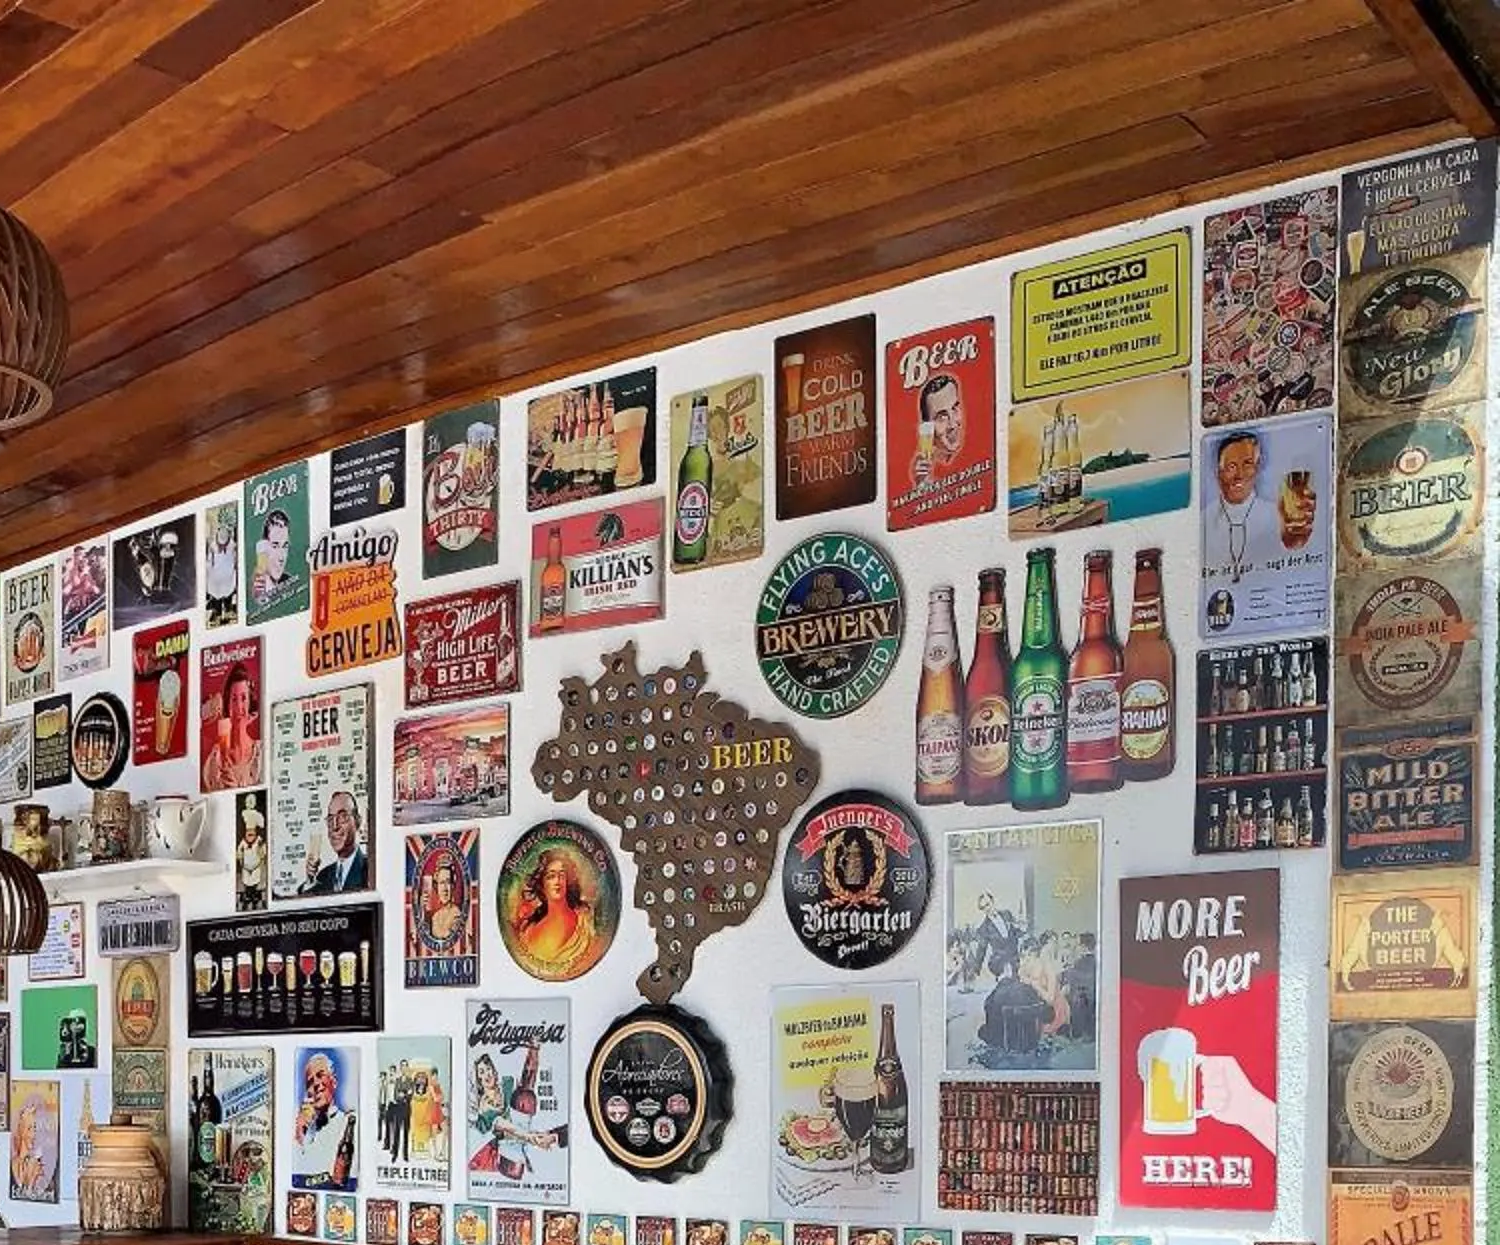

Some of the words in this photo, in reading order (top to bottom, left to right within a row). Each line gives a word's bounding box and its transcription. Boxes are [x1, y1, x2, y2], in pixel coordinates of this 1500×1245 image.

[1358, 162, 1423, 189] VERGONHA
[1425, 156, 1441, 173] NA
[1445, 147, 1479, 168] CARA
[1375, 184, 1413, 204] IGUAL
[1056, 263, 1143, 296] ATENÇÃO
[1405, 275, 1462, 299] BEER
[803, 369, 863, 401] COLD
[1379, 346, 1462, 398] Glory
[786, 391, 868, 444] BEER
[786, 447, 868, 487] FRIENDS
[1349, 471, 1473, 521] BEER
[309, 533, 393, 570] Amigo
[569, 554, 654, 589] KILLIAN'S
[764, 541, 826, 612] FLYING
[8, 572, 51, 614] BEER
[442, 594, 507, 638] Miller
[763, 605, 895, 655] BREWERY
[1397, 622, 1425, 640] PALE
[309, 616, 397, 673] CERVEJA
[436, 638, 465, 660] HIGH
[469, 633, 496, 654] LIFE
[437, 661, 487, 685] BEER
[767, 665, 813, 712] HAND
[819, 646, 890, 713] CRAFTED
[303, 707, 339, 739] BEER
[711, 736, 794, 770] BEER
[1367, 760, 1449, 788] MILD
[1347, 783, 1465, 813] BITTER
[1373, 811, 1435, 831] ALE
[235, 921, 279, 940] CERVEJA
[800, 902, 912, 939] Biergarten
[1135, 895, 1247, 942] MORE
[1385, 905, 1418, 924] THE
[1371, 927, 1432, 948] PORTER
[1376, 948, 1428, 966] BEER
[1182, 945, 1261, 1006] Beer
[1142, 1155, 1253, 1188] HERE!
